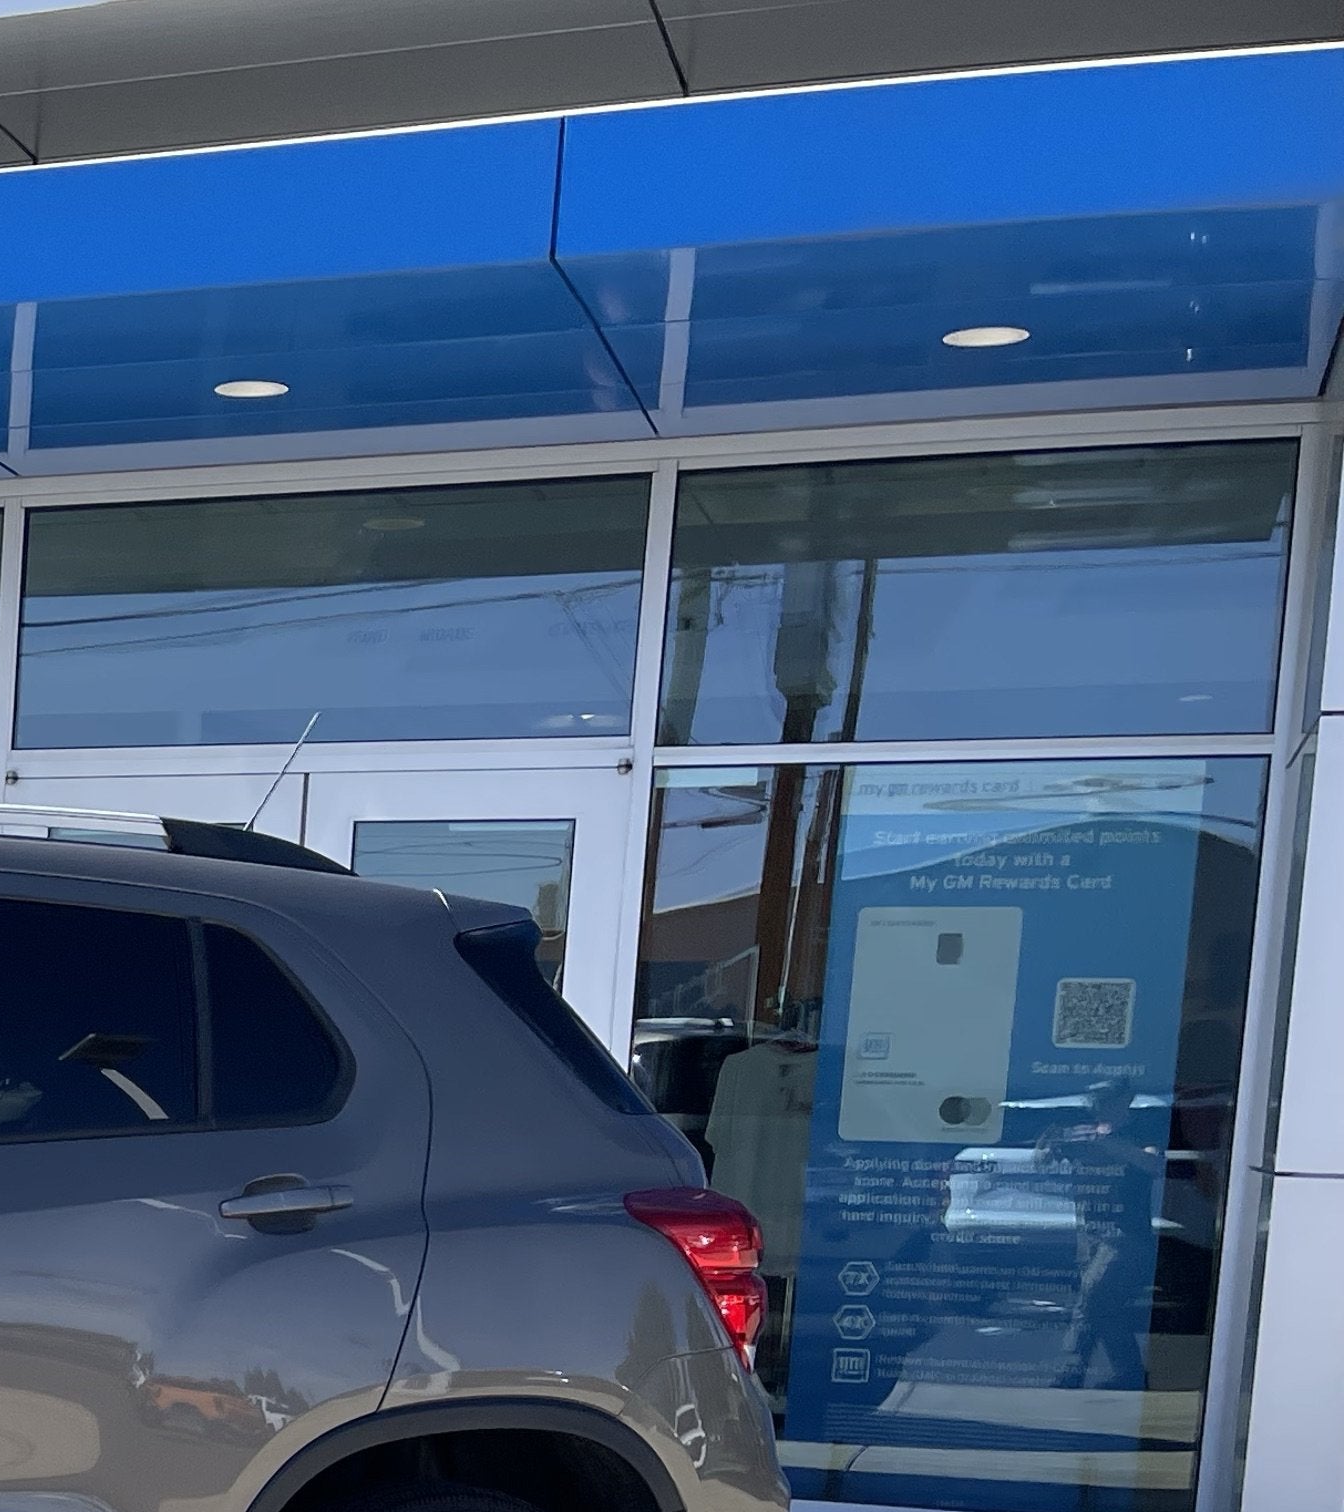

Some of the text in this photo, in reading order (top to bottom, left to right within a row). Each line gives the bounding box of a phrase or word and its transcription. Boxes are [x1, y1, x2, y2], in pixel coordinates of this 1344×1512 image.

[910, 874, 1113, 893] My GM Rewards Card
